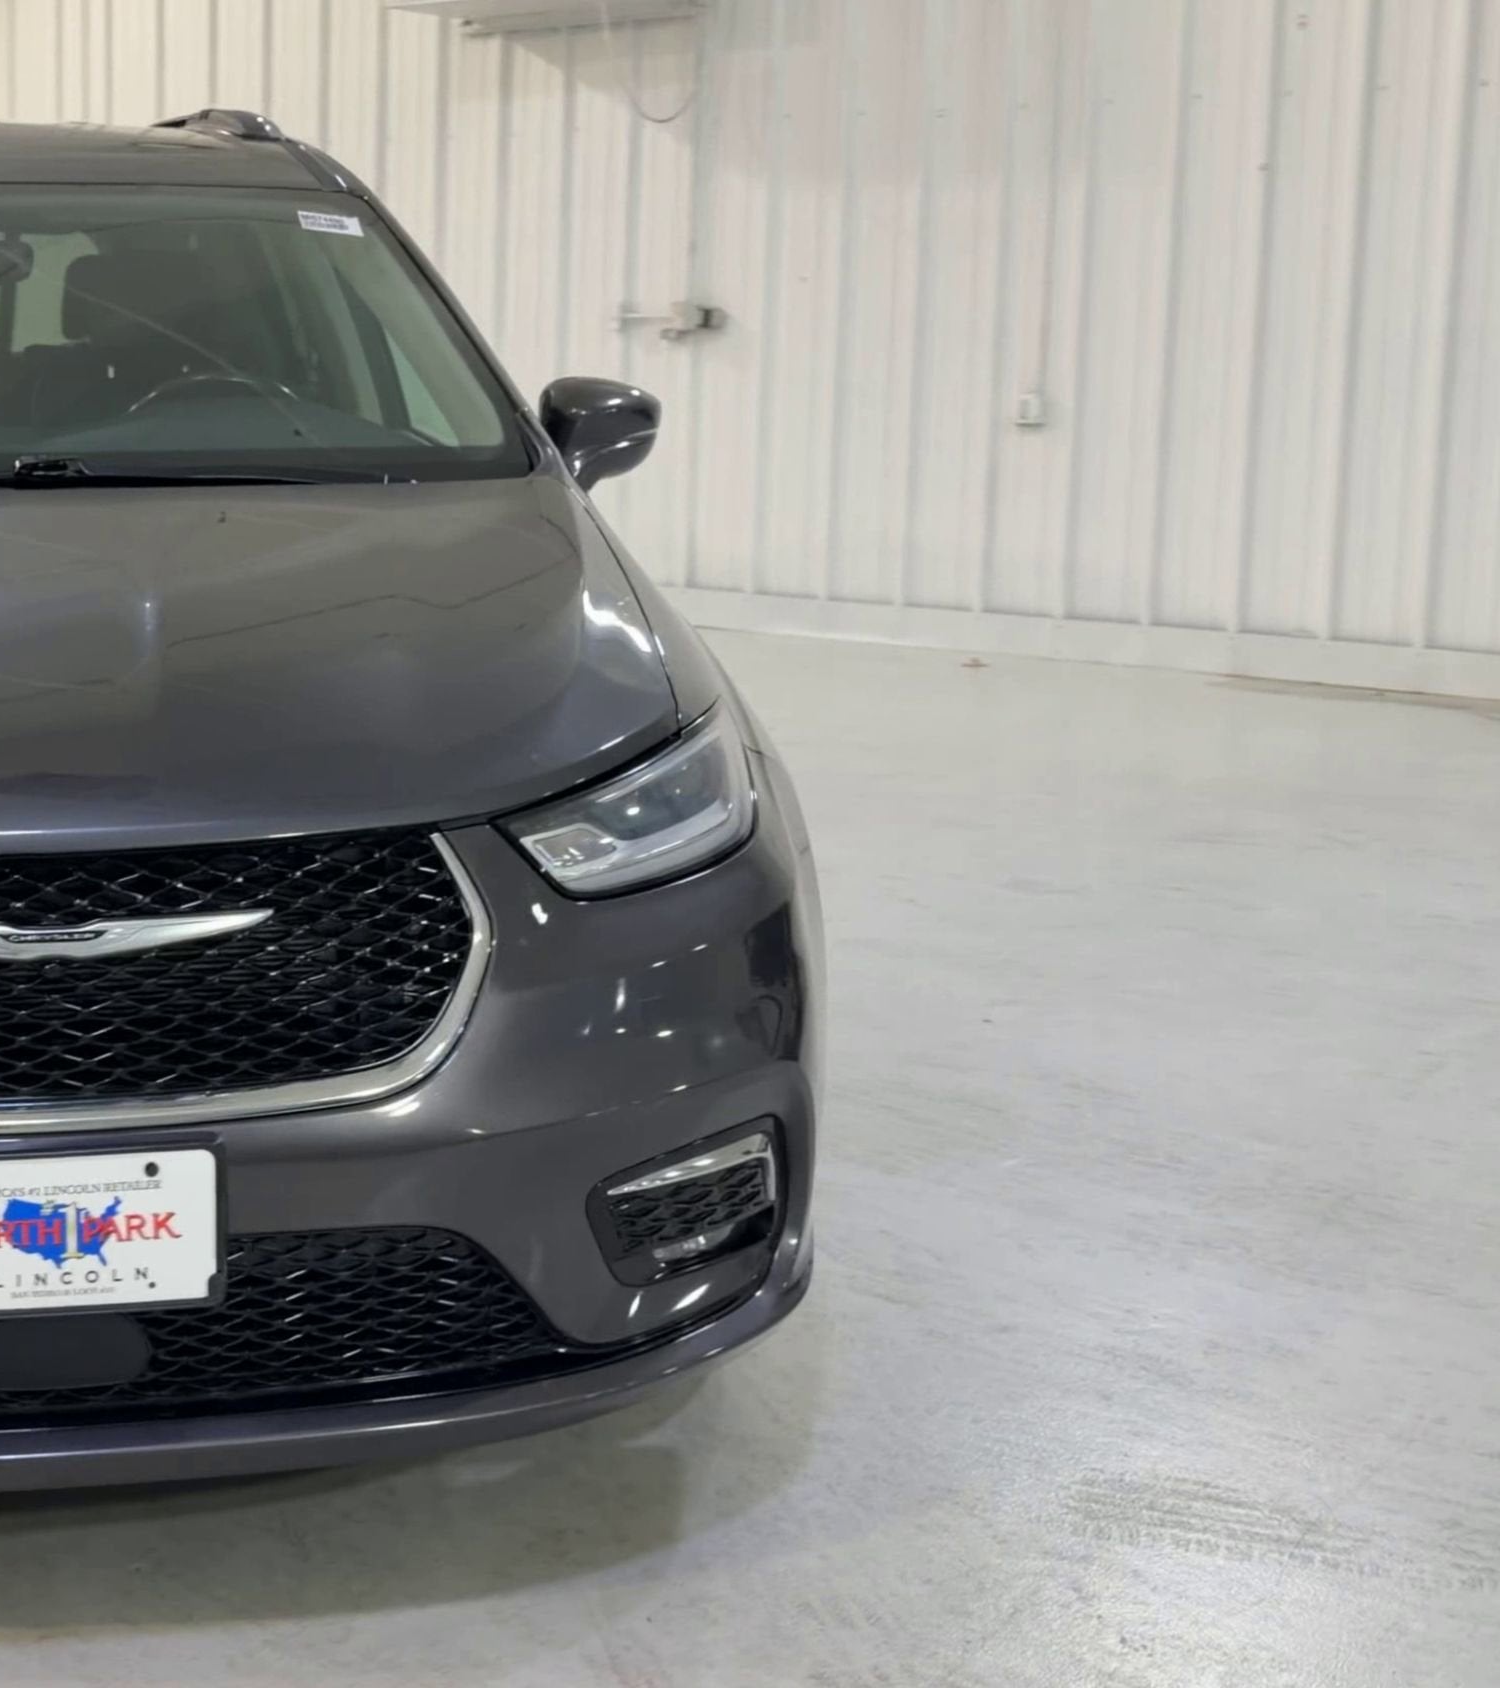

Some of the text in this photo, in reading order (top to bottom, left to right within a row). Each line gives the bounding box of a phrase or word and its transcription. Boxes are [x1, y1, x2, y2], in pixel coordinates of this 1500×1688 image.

[43, 1185, 100, 1196] LINCOLN
[103, 1180, 162, 1193] RETAILER
[82, 1212, 182, 1243] PARK
